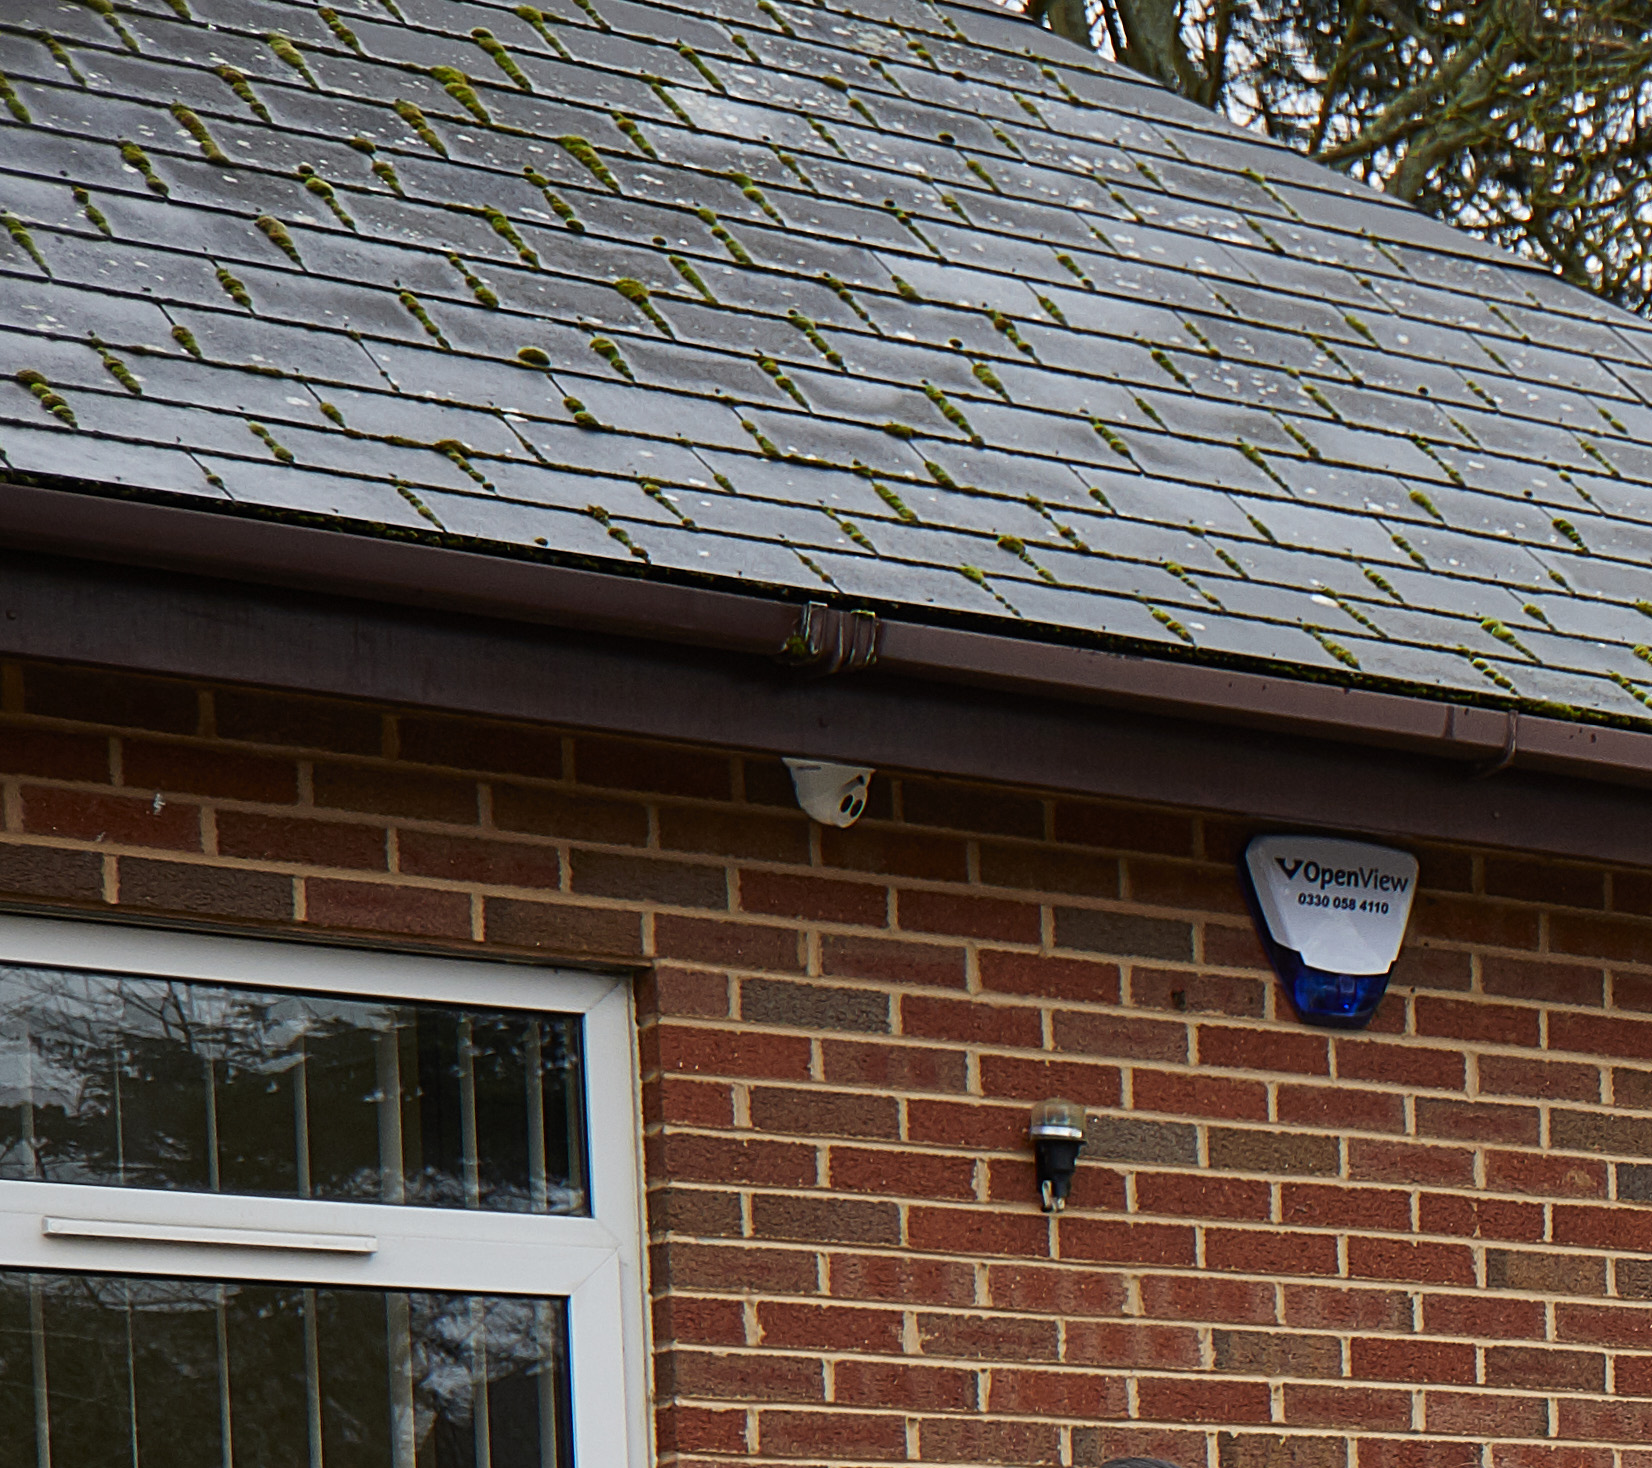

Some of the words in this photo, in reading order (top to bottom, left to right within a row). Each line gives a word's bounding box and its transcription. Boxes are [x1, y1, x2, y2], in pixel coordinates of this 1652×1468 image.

[1303, 861, 1409, 892] OpenView
[1298, 892, 1330, 908] 0330
[1333, 896, 1356, 911] 058
[1359, 901, 1389, 915] 4110
